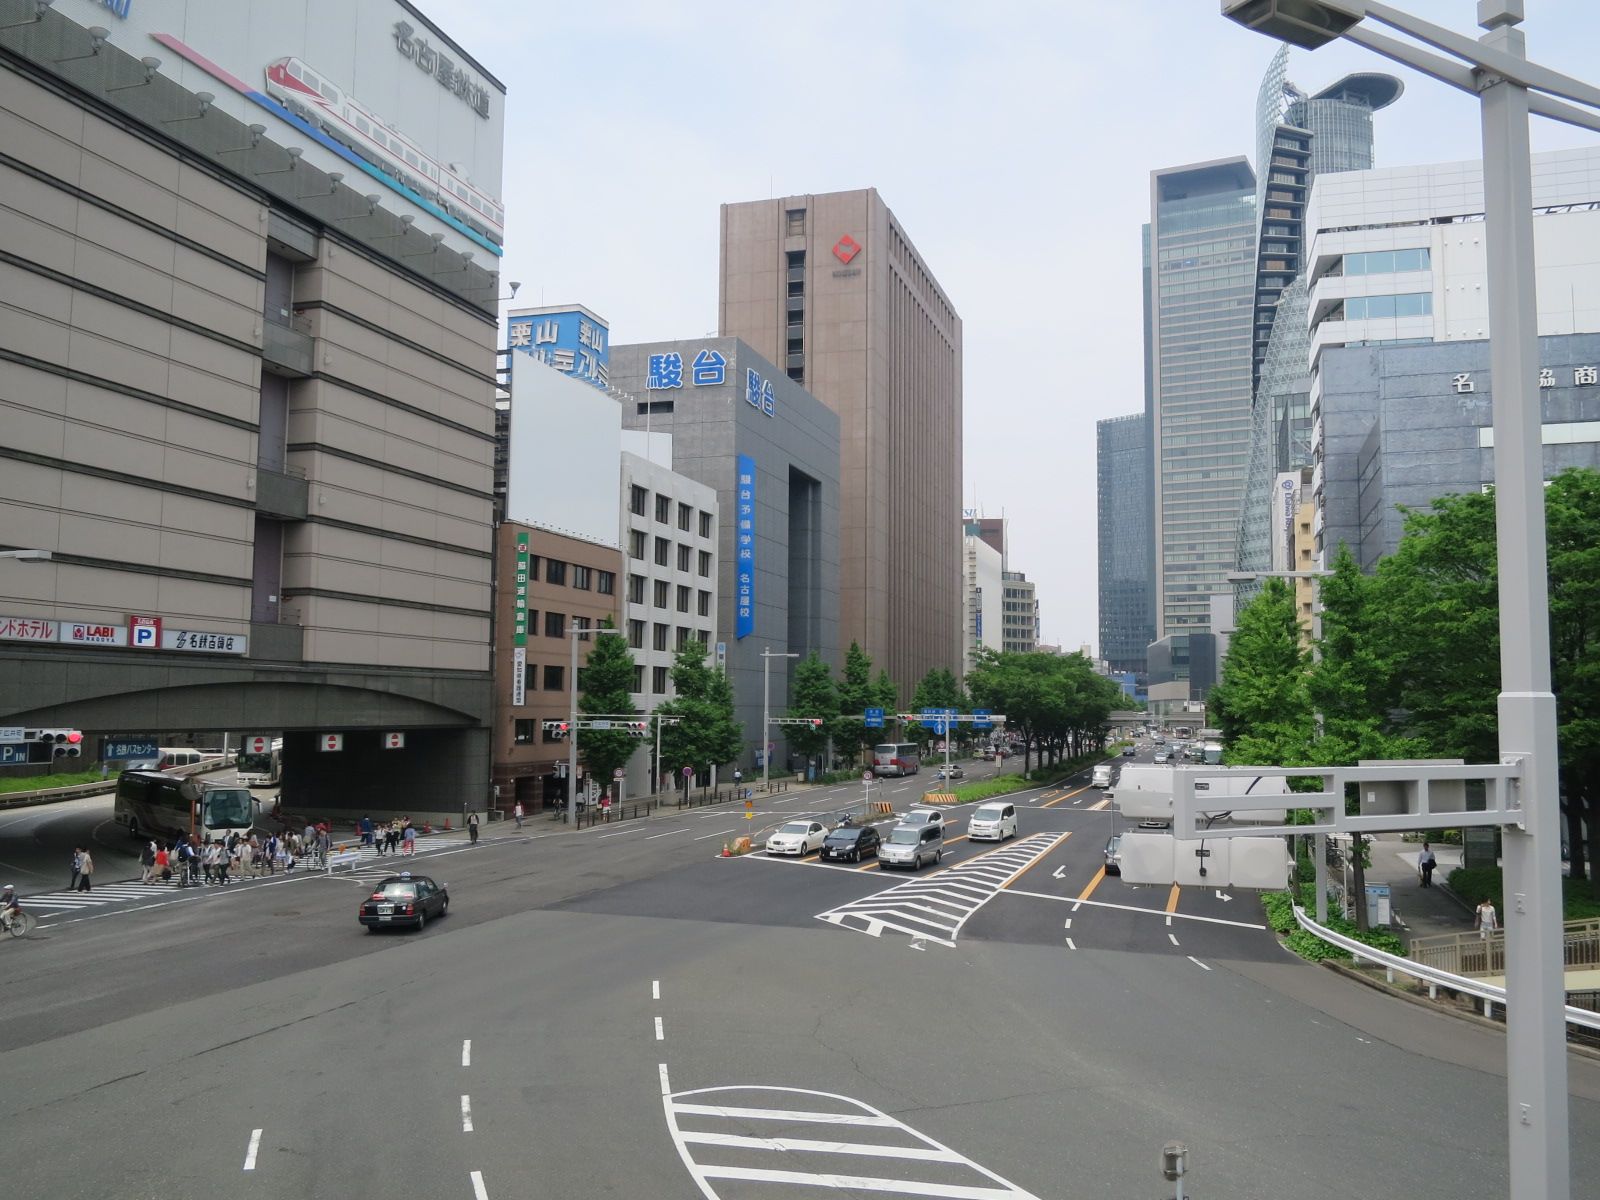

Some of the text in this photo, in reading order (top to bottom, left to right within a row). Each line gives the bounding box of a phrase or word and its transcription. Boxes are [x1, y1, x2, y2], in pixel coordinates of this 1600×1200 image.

[392, 20, 490, 119] 名古屋鉄道
[646, 349, 726, 389] 駿台
[745, 367, 774, 418] 駿台
[87, 626, 115, 637] LABI
[137, 628, 152, 643] P
[190, 634, 234, 650] 名鉄百貨店
[3, 746, 26, 762] P IN
